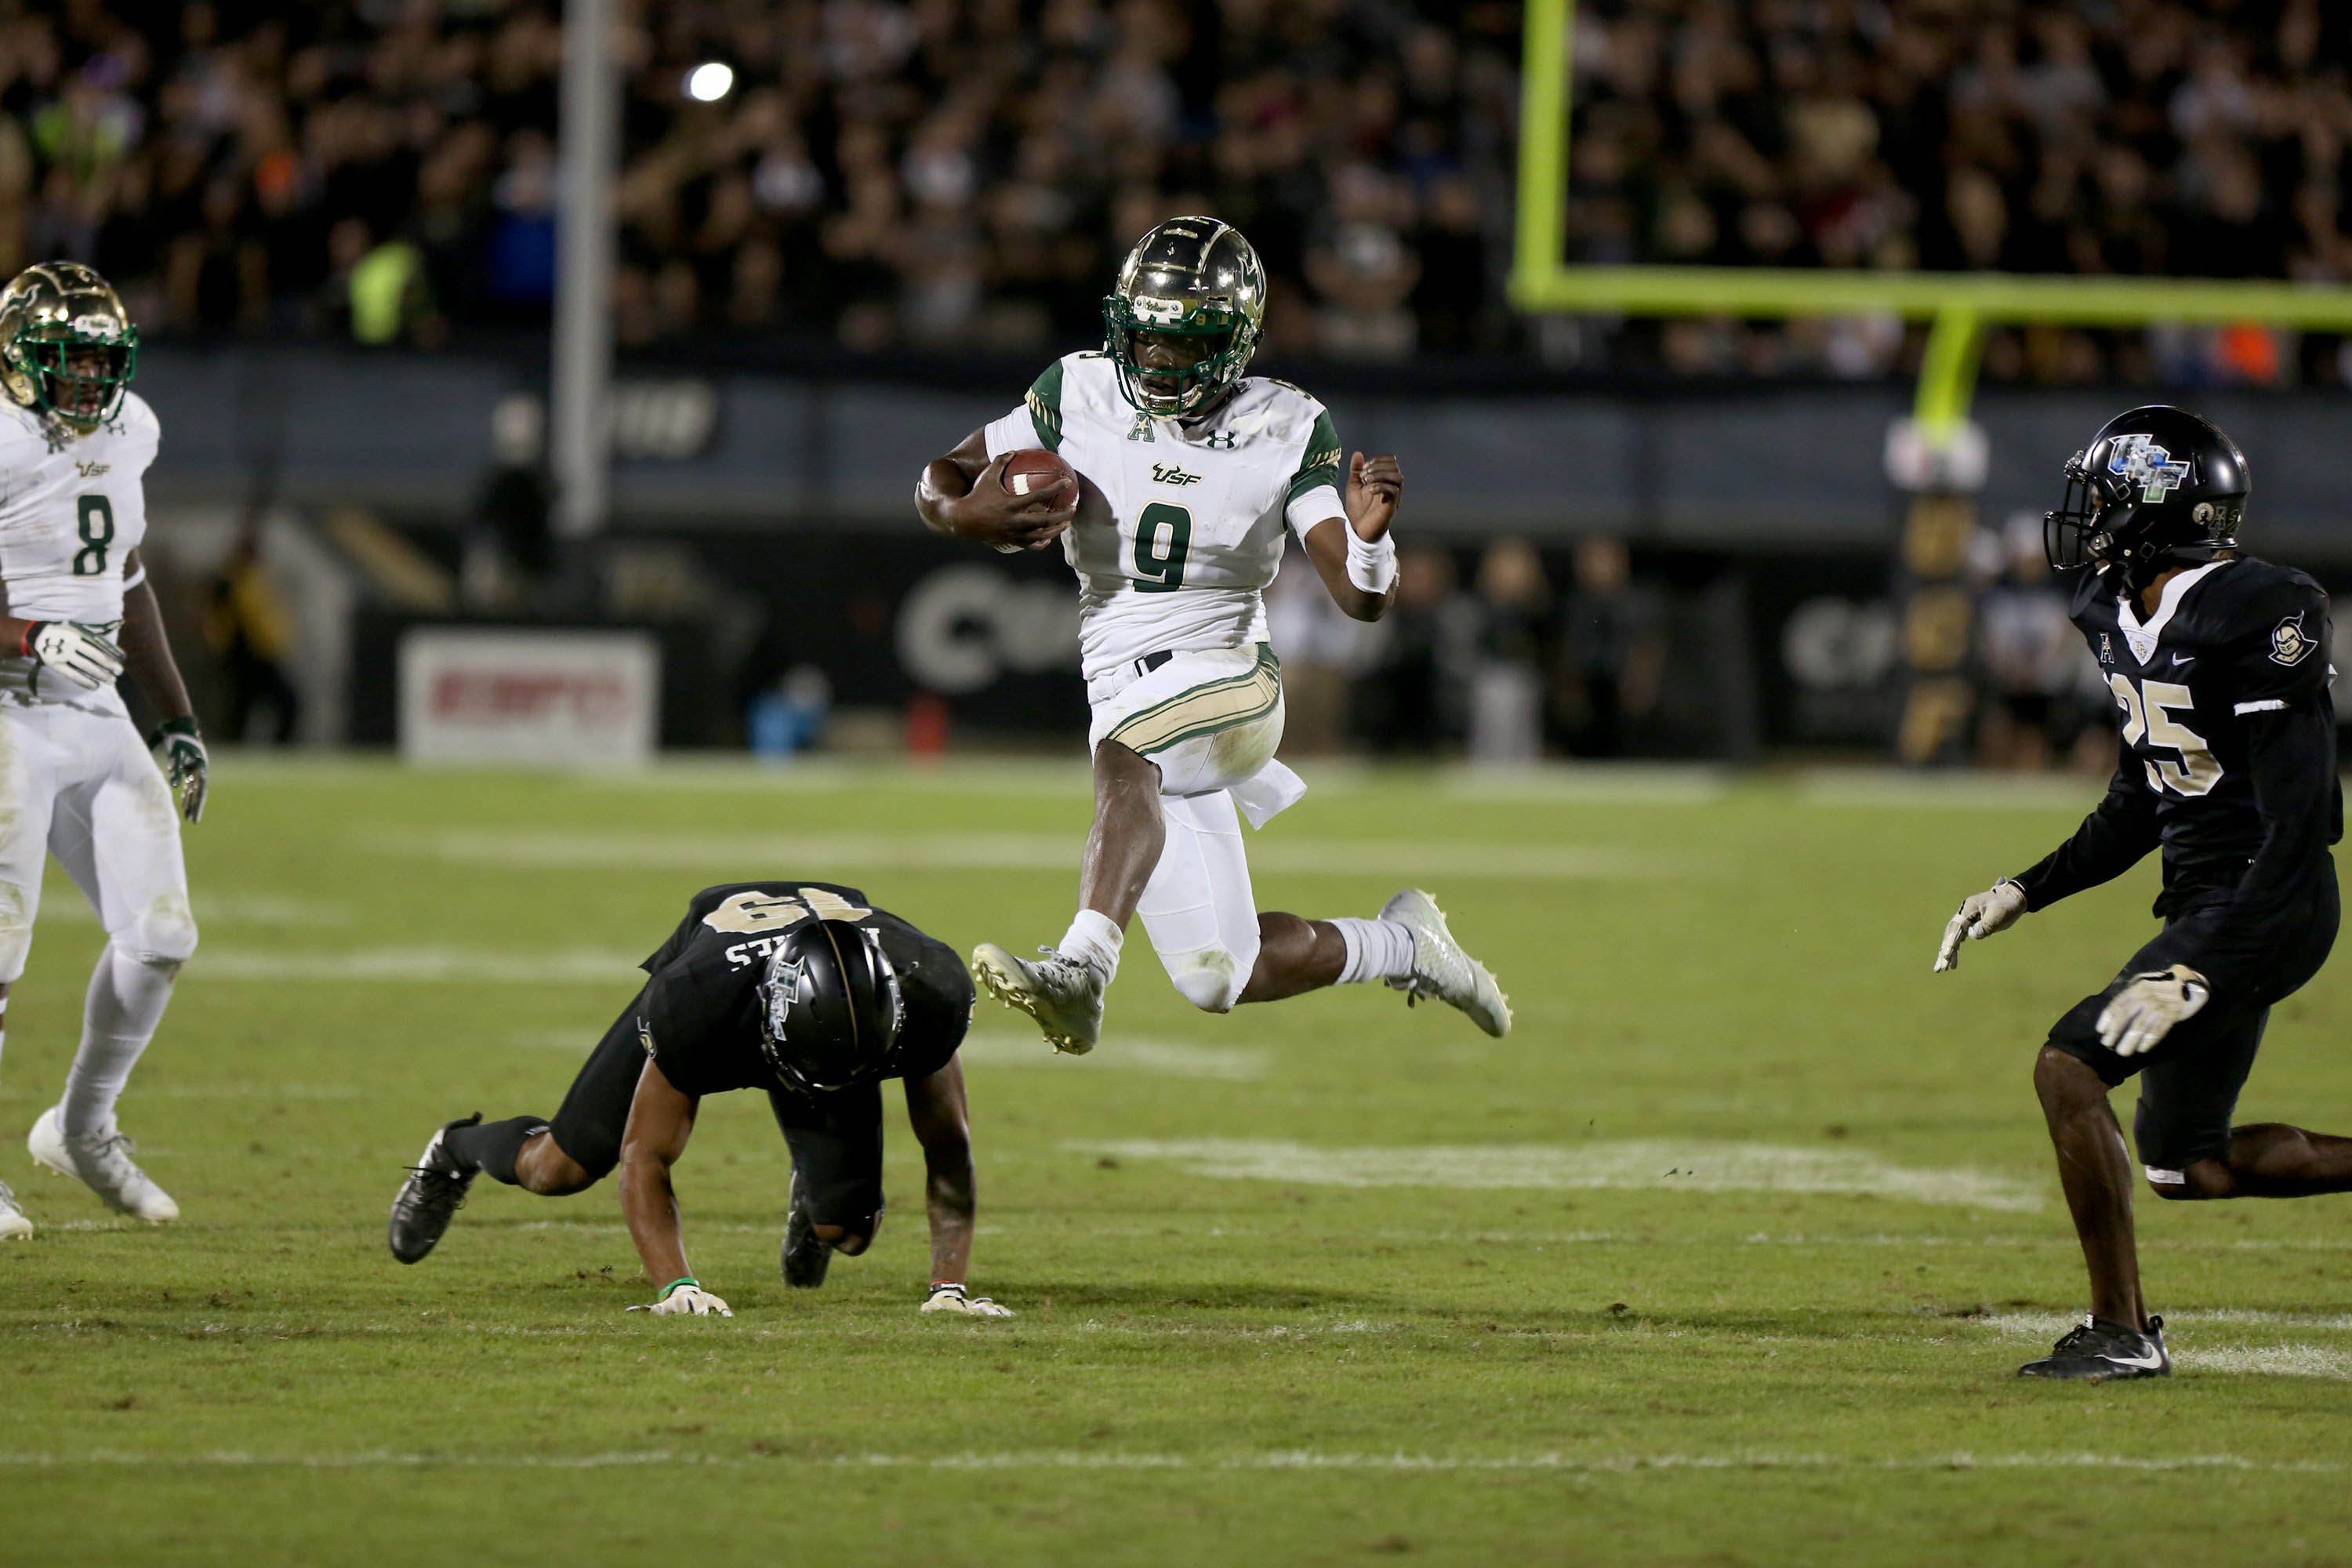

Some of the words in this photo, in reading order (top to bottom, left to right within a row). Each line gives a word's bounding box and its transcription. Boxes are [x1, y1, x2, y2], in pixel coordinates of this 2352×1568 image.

[76, 459, 111, 477] USF
[1152, 461, 1203, 486] USF
[74, 494, 114, 575] 8
[1131, 500, 1193, 593] 9
[702, 887, 873, 935] 19
